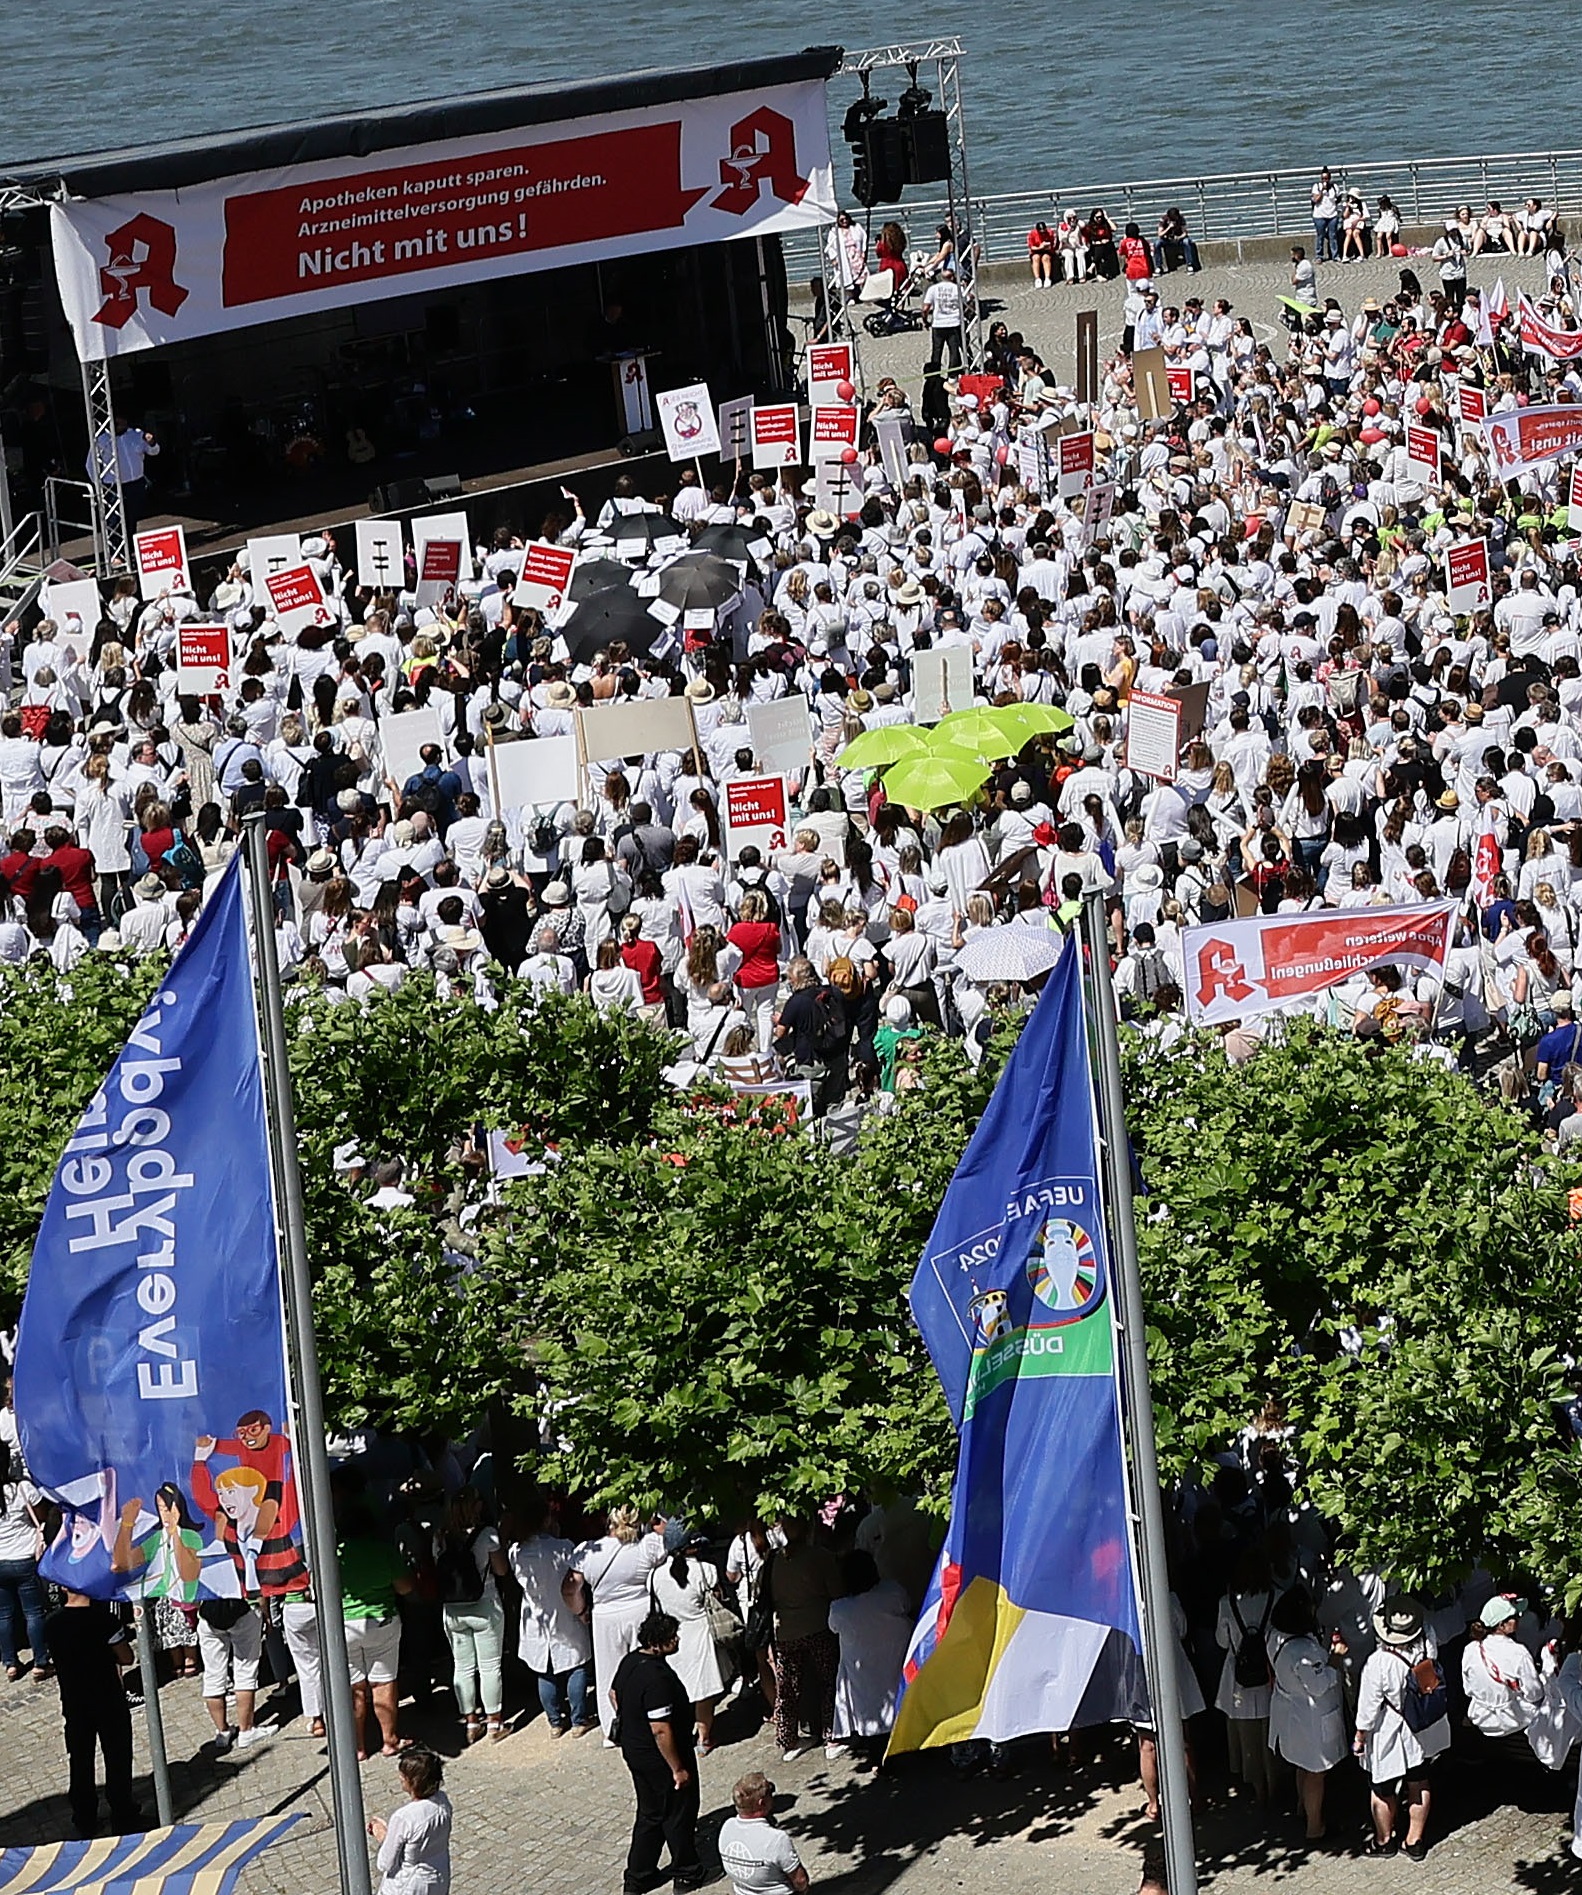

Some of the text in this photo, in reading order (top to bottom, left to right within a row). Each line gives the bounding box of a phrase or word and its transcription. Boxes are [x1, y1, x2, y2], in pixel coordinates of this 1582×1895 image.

[298, 172, 607, 238] Arzneimittelversorgung gefährden.
[299, 164, 530, 214] Apotheken kaputt sparen.
[298, 239, 385, 278] Nicht
[394, 227, 448, 259] mit
[200, 654, 221, 662] uns!
[730, 802, 760, 812] Nicht
[731, 808, 775, 822] mit uns!
